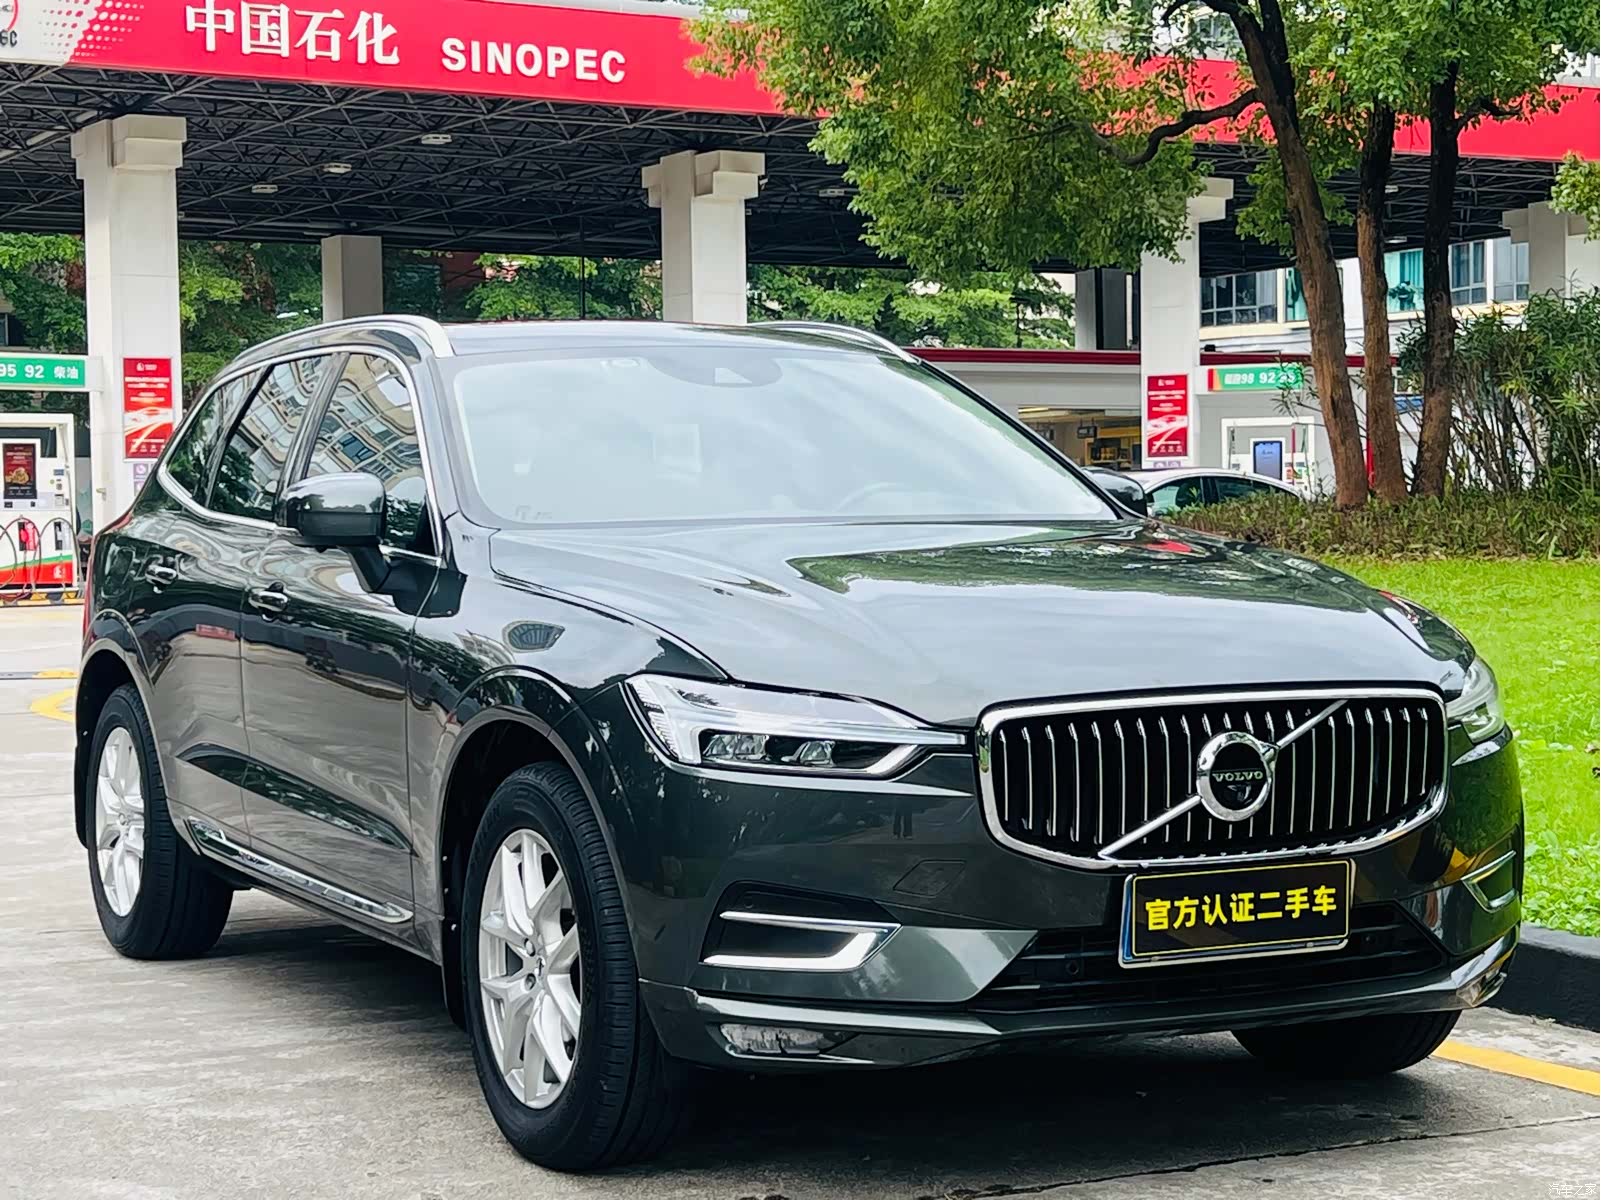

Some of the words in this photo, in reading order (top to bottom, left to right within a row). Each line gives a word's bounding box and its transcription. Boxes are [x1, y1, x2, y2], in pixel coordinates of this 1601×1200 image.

[185, 0, 400, 65] 中国石化
[441, 37, 626, 83] SINOPEC
[24, 364, 45, 379] 92
[54, 366, 79, 379] 柴油
[1259, 372, 1276, 384] 92
[1212, 771, 1264, 782] VOLVO
[1145, 885, 1337, 931] 官方认证二手车
